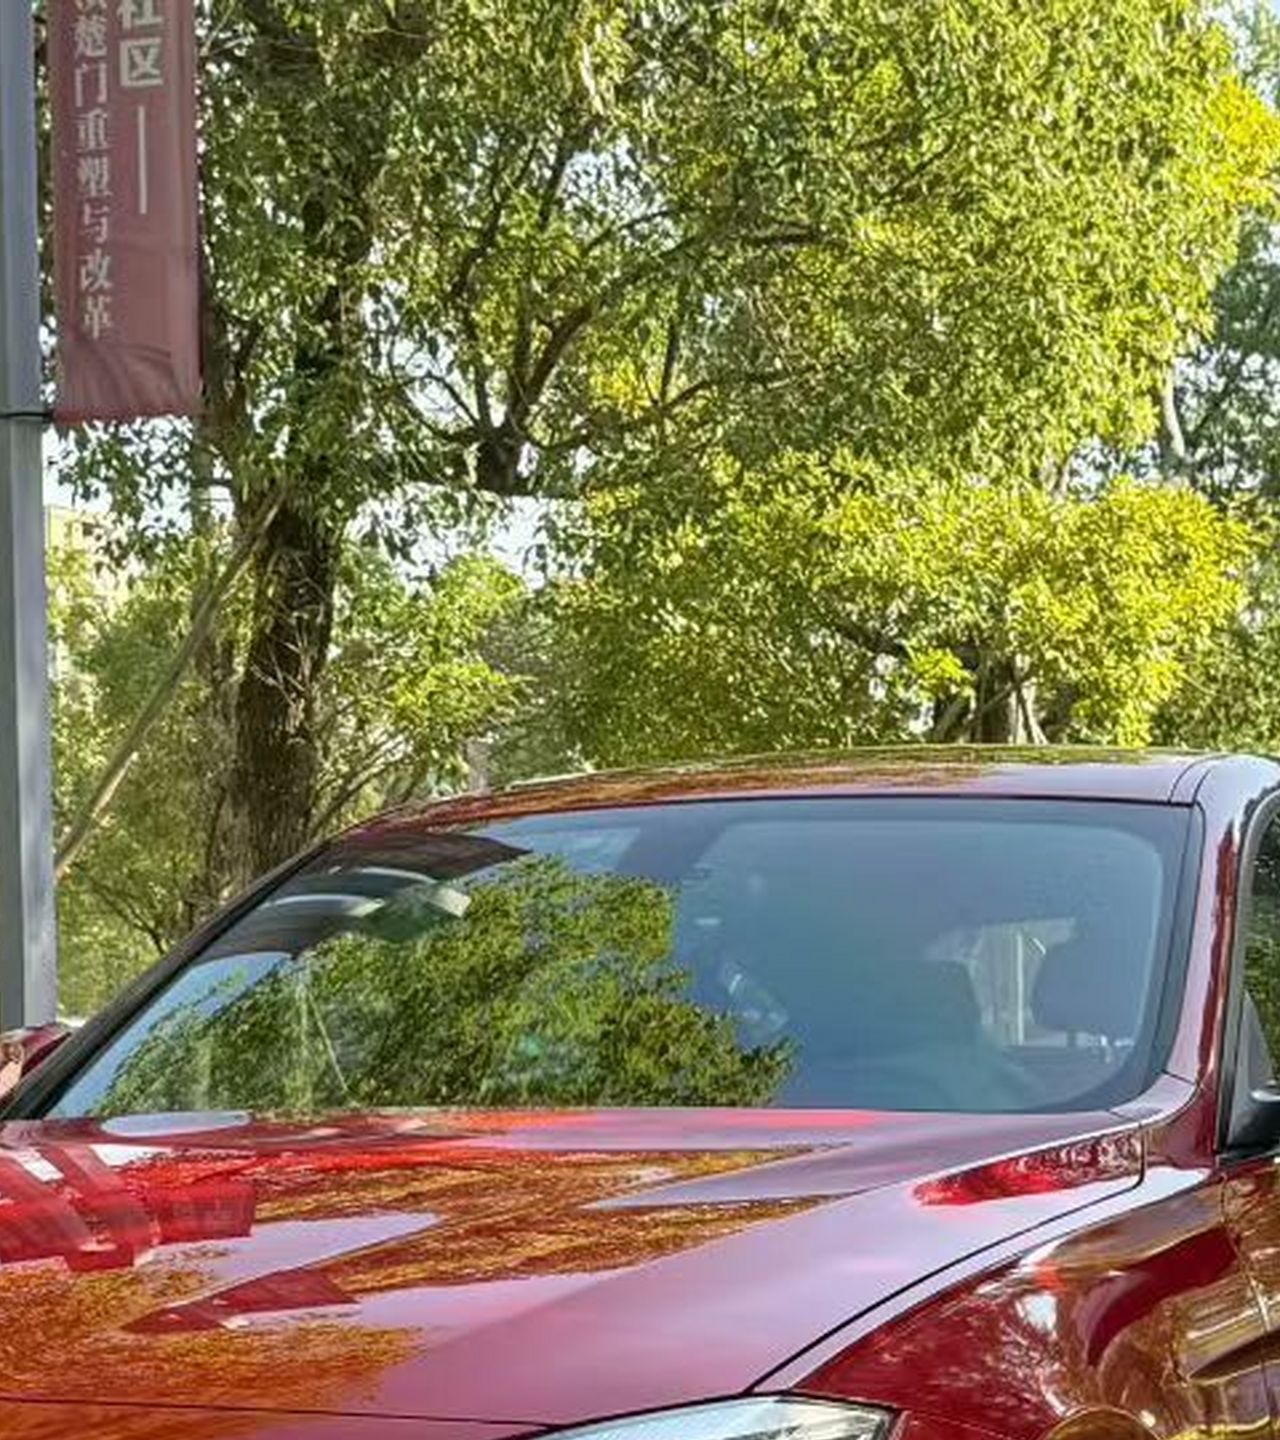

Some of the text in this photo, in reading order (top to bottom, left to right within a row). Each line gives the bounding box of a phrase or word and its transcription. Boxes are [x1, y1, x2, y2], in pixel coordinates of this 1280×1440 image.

[73, 0, 115, 340] 楚门重塑与改革
